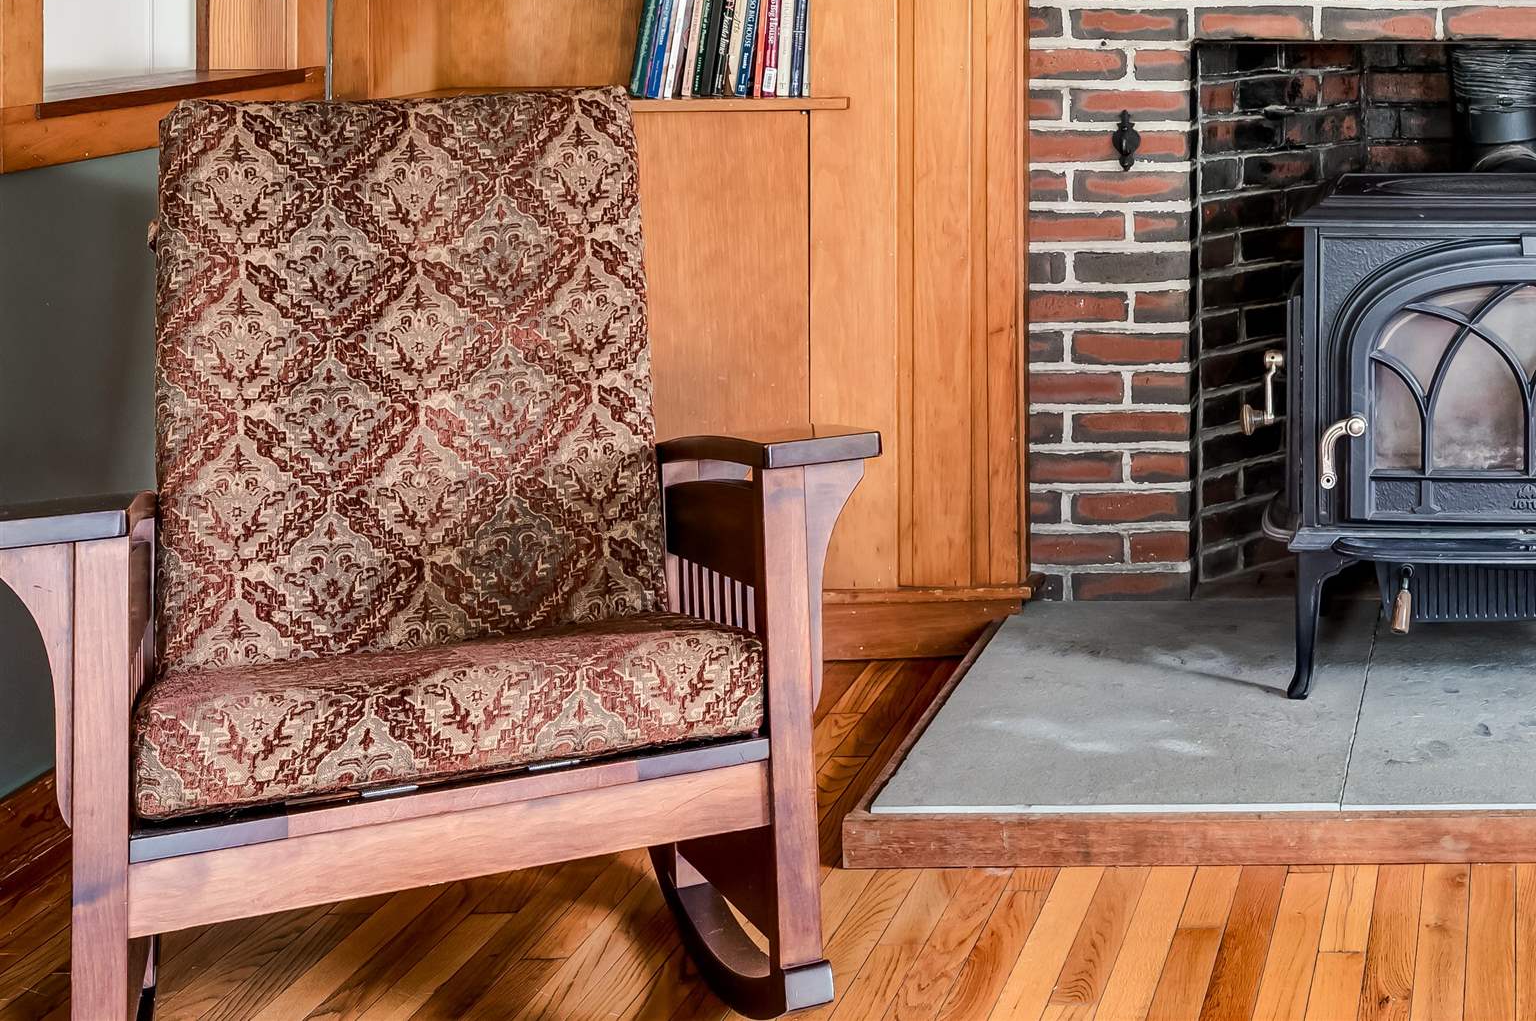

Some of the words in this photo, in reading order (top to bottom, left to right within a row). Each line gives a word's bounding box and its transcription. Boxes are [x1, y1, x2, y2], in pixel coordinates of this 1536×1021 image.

[749, 0, 756, 9] SO
[747, 9, 755, 22] BIG
[744, 24, 753, 47] HOUSE
[767, 17, 776, 44] House
